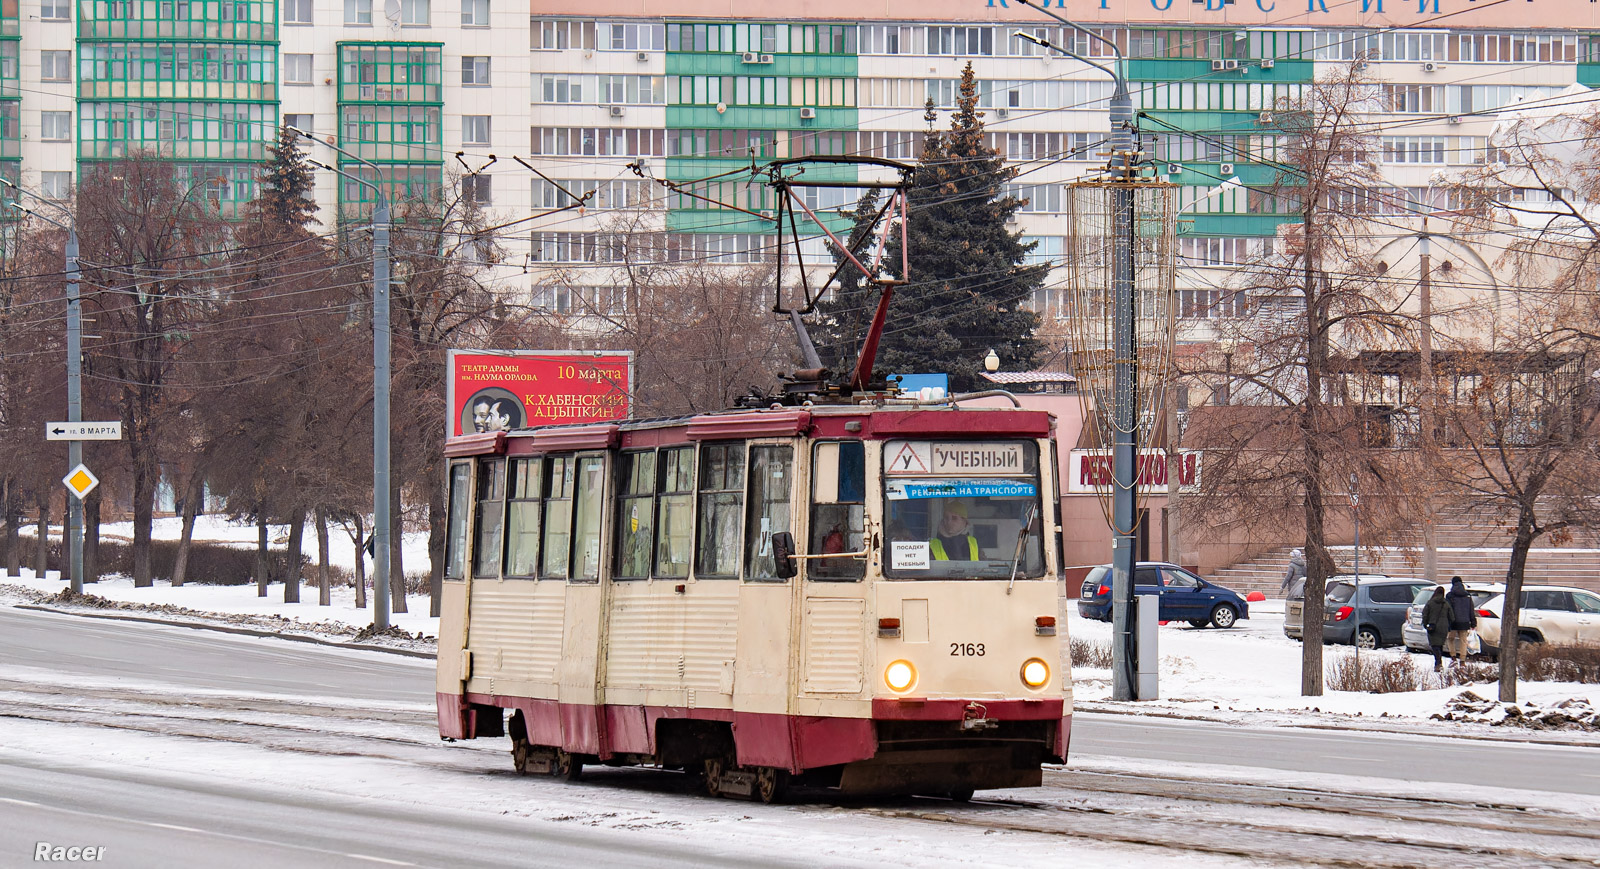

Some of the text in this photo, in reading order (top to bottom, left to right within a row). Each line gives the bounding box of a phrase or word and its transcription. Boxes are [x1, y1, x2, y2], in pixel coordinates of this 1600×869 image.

[461, 364, 519, 373] ТЕАТР ДРАМЫ
[557, 365, 622, 384] 10 марта
[939, 447, 1018, 468] УЧЕБНЫЙ
[911, 486, 1034, 497] РЕКЛАМА НА ТРАНСПОРТЕ
[950, 642, 986, 657] 2163
